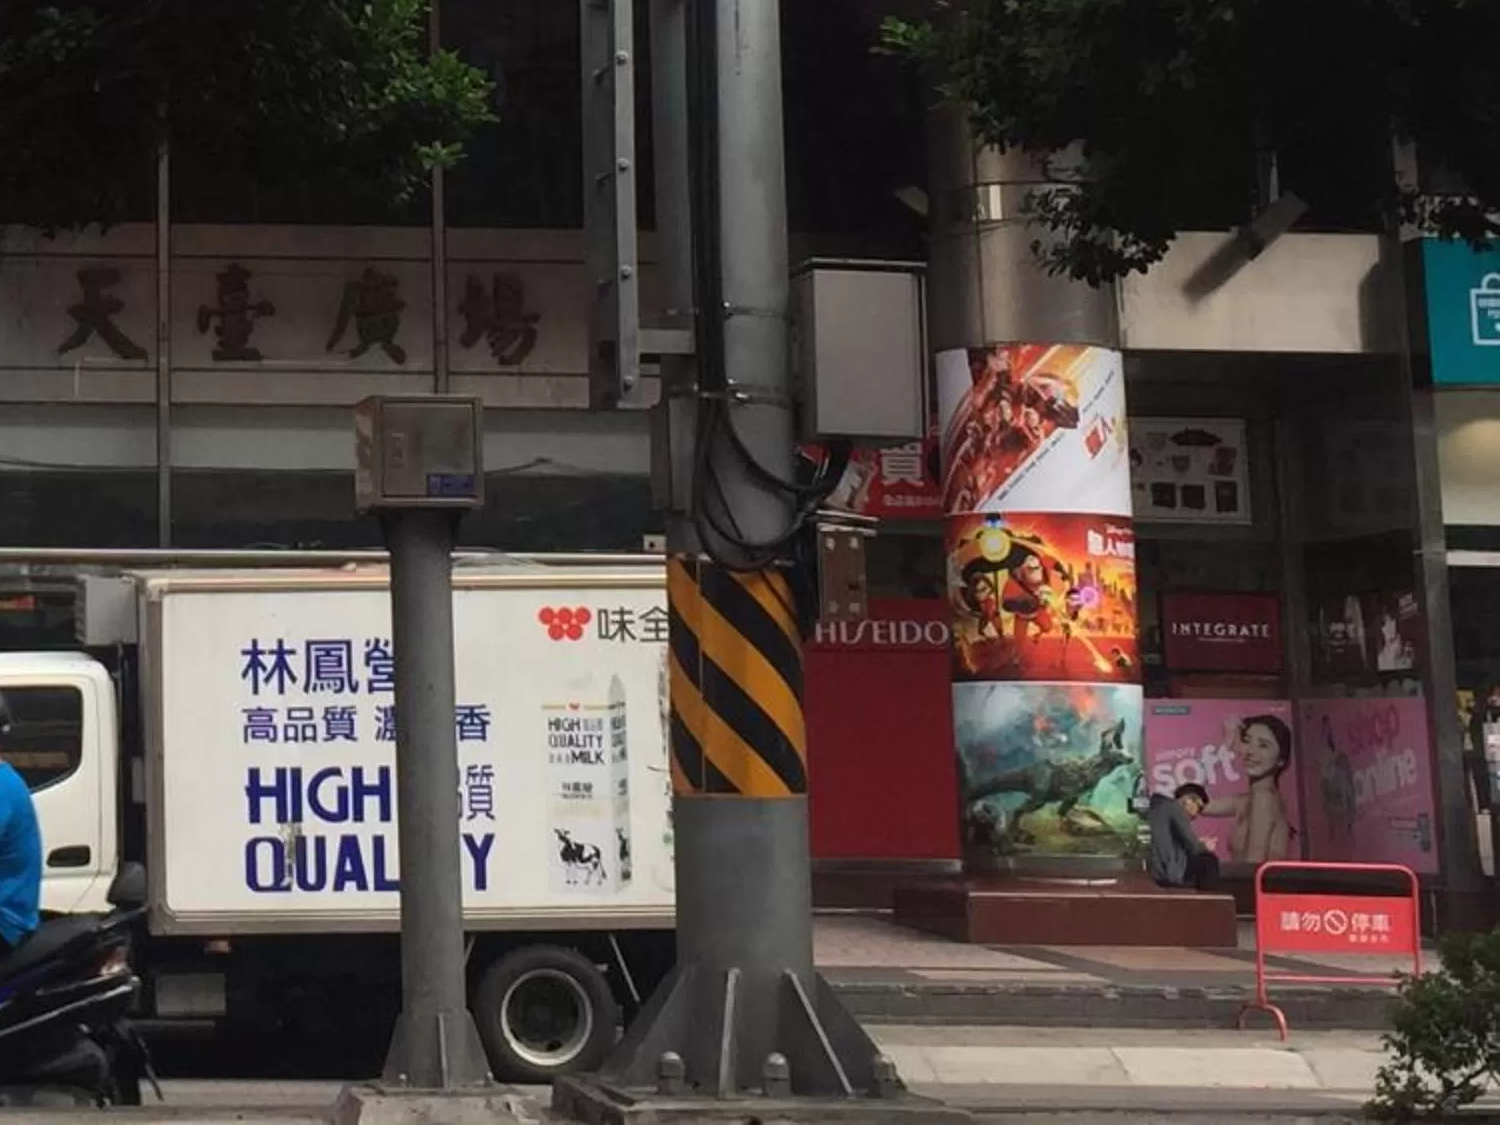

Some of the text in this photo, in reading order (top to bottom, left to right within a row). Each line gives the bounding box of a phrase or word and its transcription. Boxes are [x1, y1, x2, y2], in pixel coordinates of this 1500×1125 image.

[814, 618, 949, 645] HISEIDO
[1171, 621, 1269, 639] INTEGRATE
[242, 706, 358, 744] 高品質
[547, 716, 581, 732] HIGH
[547, 733, 604, 748] QUALITY
[245, 766, 392, 824] HIGH
[457, 764, 496, 821] 質
[245, 832, 496, 893] QUALY
